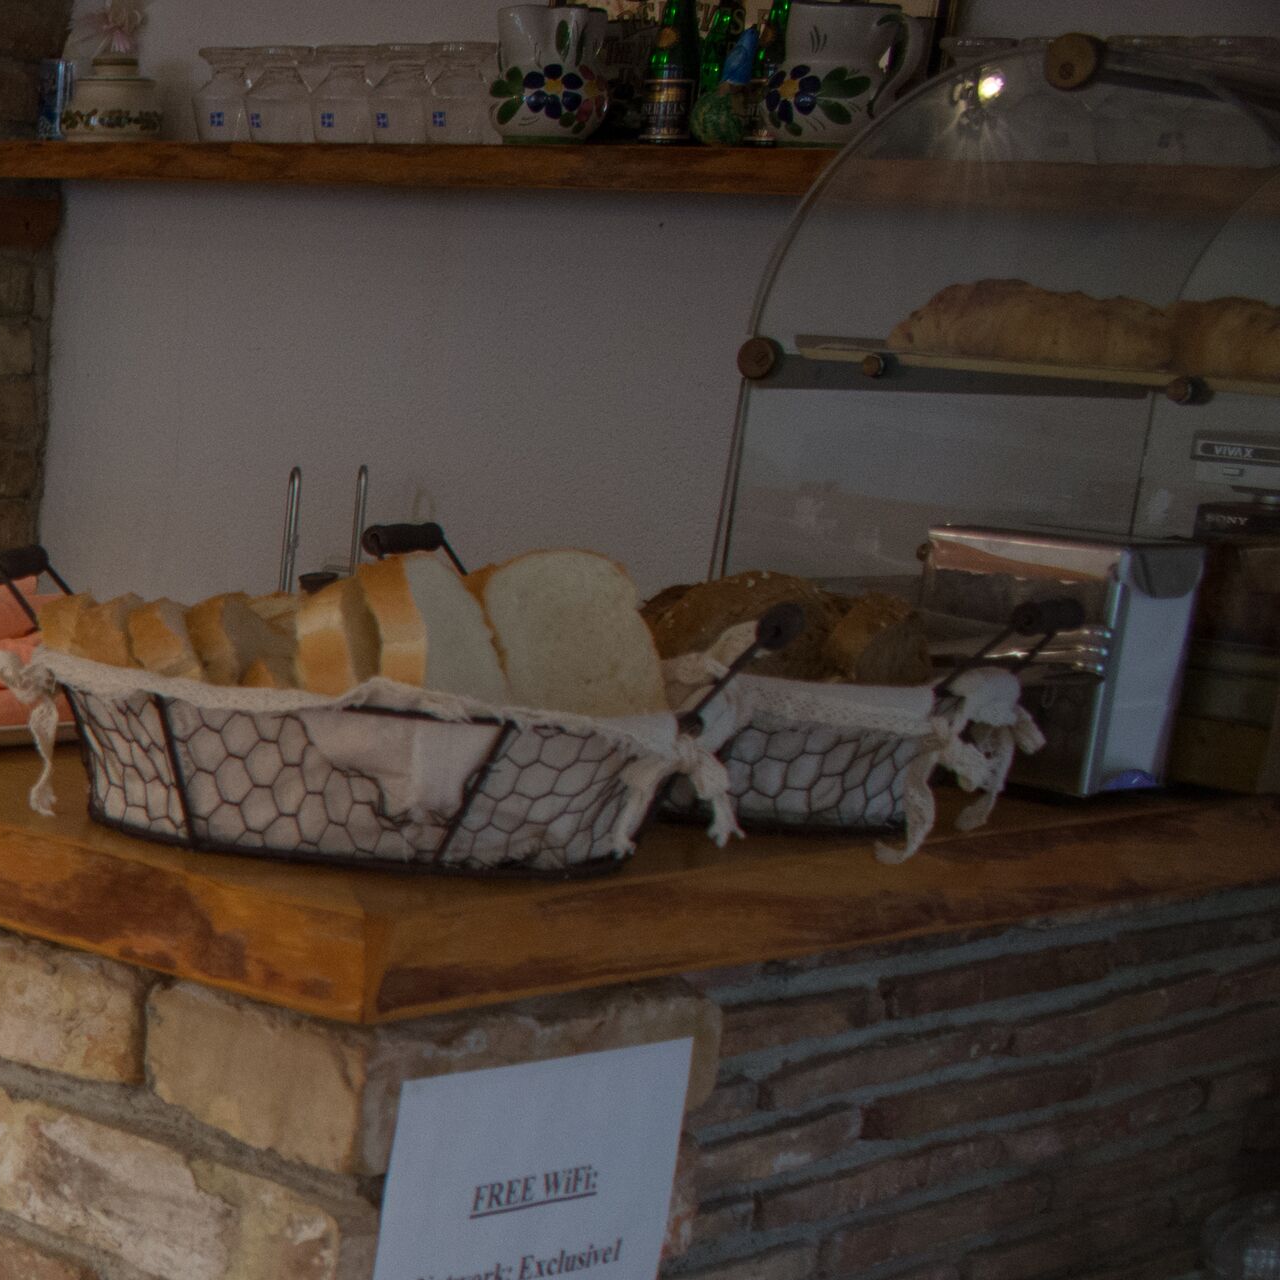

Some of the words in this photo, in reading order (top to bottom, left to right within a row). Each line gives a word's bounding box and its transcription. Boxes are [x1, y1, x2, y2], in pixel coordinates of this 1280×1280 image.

[1214, 445, 1254, 458] VIVAX
[1204, 513, 1248, 526] SONY
[471, 1175, 537, 1217] FREE
